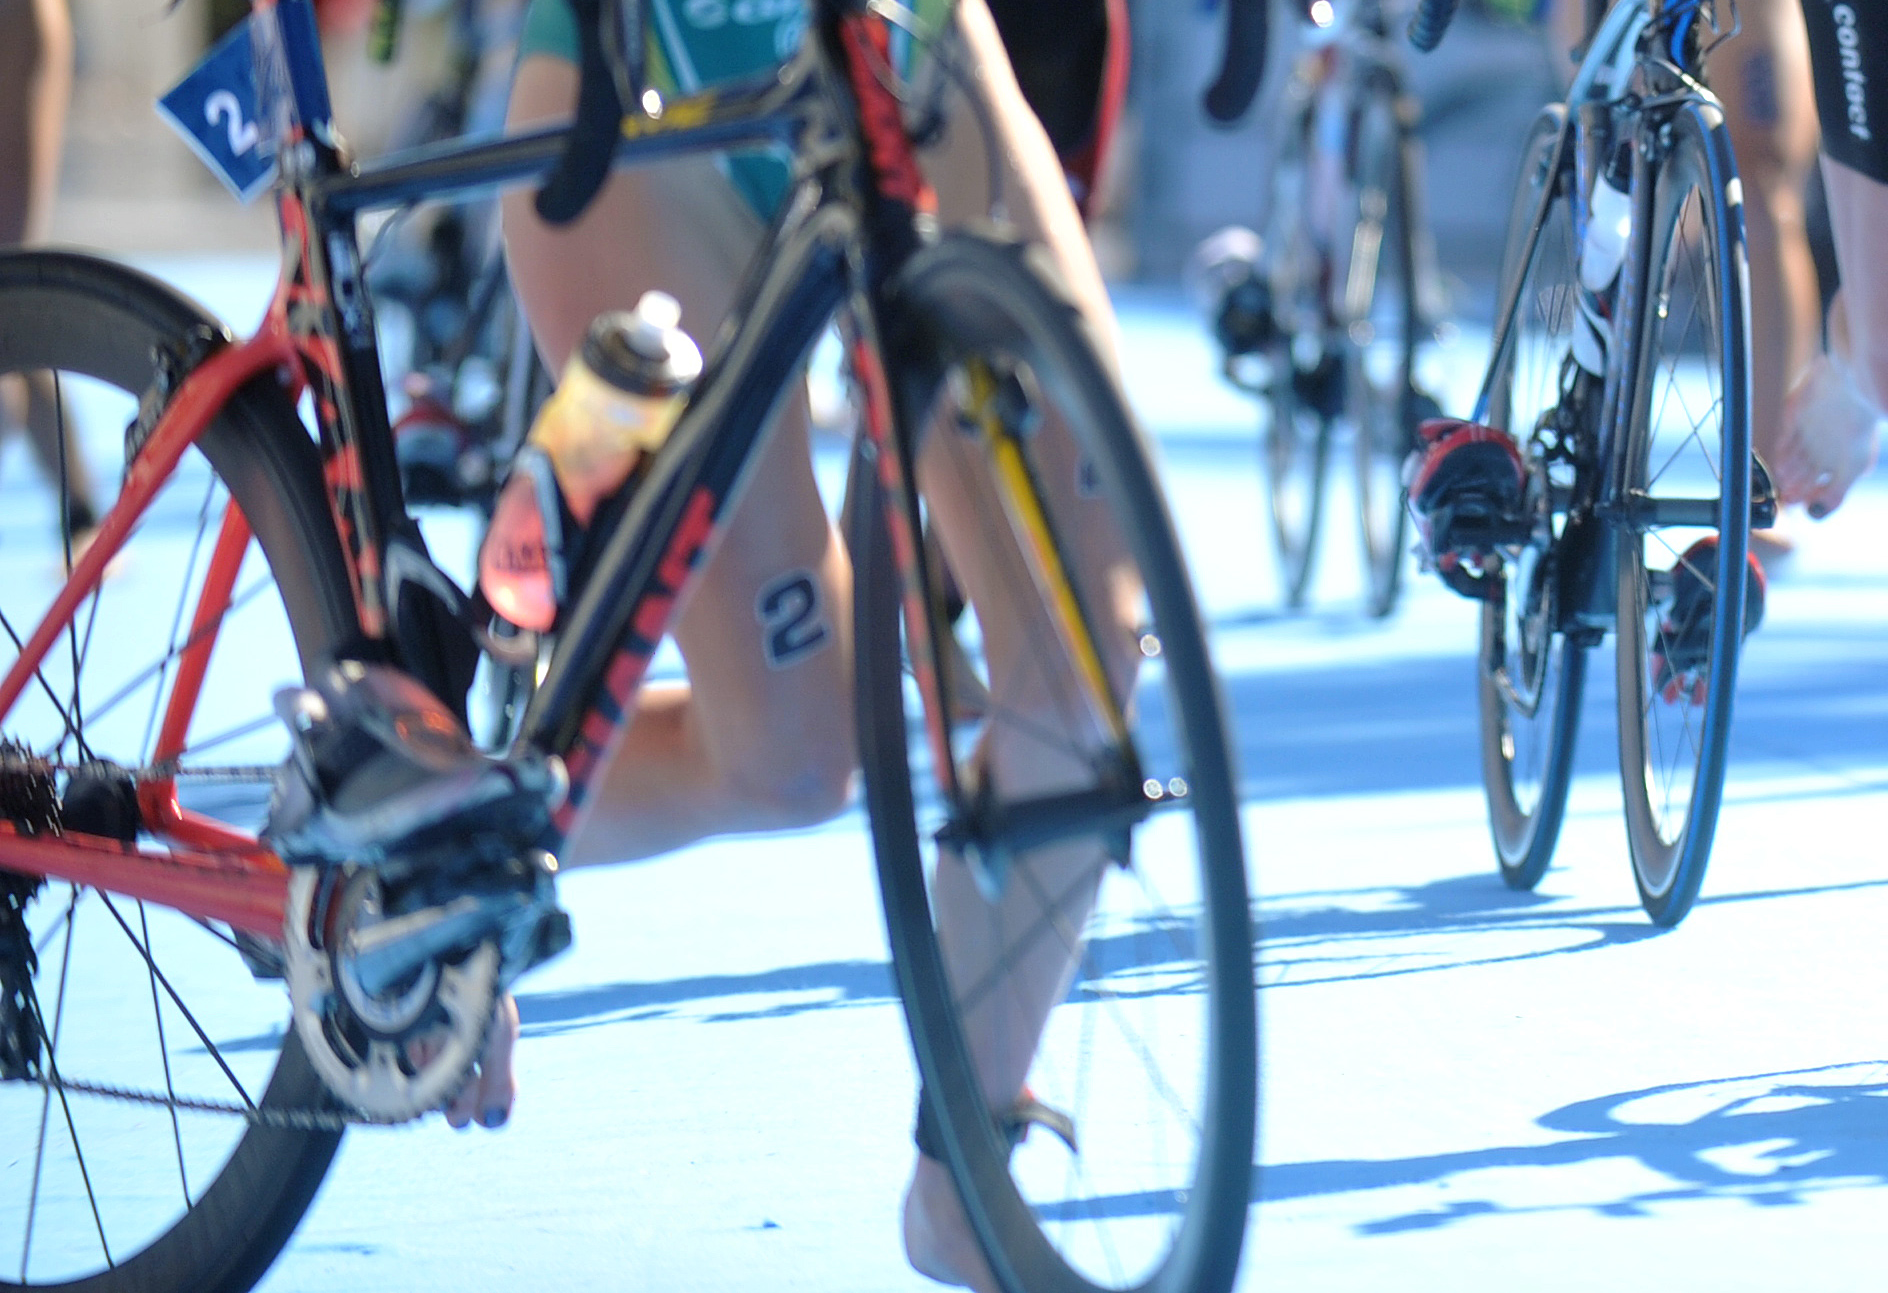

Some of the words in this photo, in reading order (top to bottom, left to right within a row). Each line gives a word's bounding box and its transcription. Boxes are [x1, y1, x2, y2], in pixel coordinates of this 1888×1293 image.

[1832, 4, 1873, 141] contact
[203, 88, 259, 157] 2
[762, 576, 826, 658] 2
